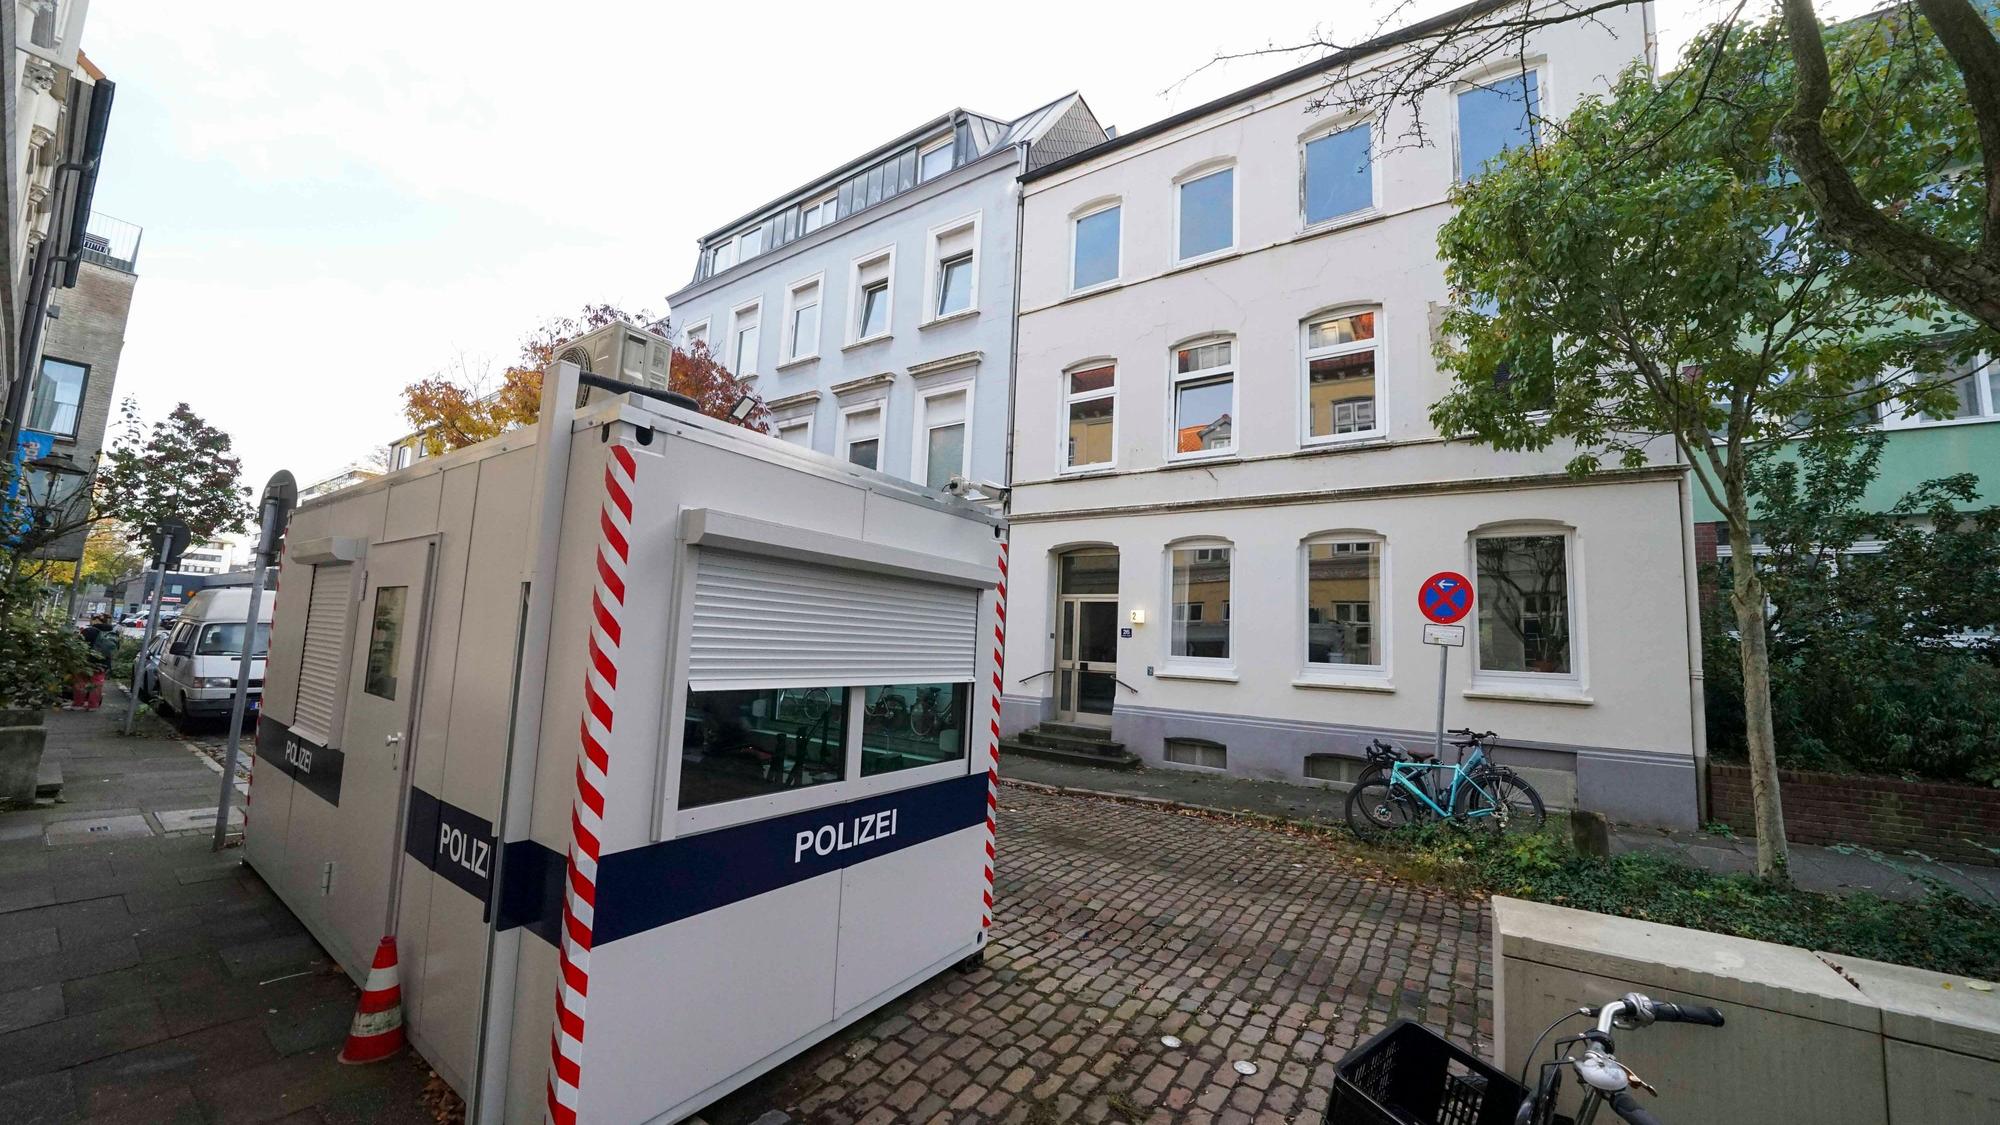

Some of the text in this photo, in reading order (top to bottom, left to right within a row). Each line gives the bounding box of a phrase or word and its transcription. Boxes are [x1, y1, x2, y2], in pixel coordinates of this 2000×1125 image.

[285, 740, 312, 774] POLIZEI
[439, 822, 491, 880] POLIZ
[794, 808, 898, 864] POLIZEI
